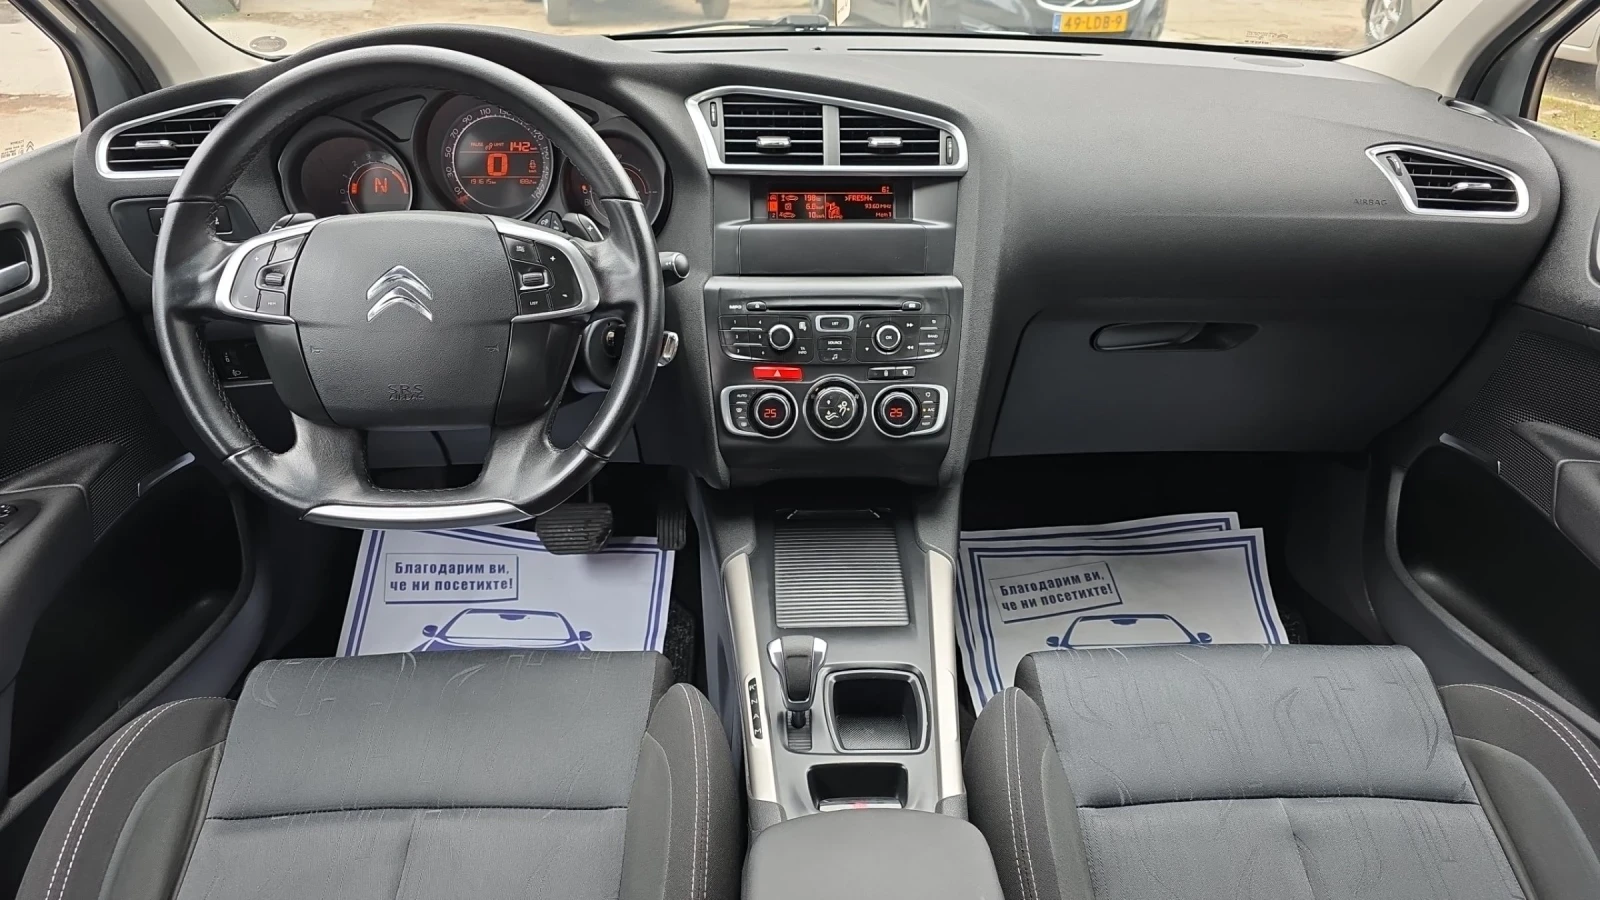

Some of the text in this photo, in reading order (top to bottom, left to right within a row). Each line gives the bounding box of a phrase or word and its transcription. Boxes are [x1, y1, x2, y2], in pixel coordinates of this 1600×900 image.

[1063, 15, 1123, 31] 49-LDB-9
[479, 107, 491, 116] 110
[462, 114, 473, 124] 90
[450, 128, 459, 139] 70
[510, 141, 530, 151] 142
[444, 146, 452, 158] 50
[487, 153, 508, 176] 0
[445, 166, 453, 178] 30
[374, 177, 388, 193] N
[453, 185, 462, 196] 10
[1353, 198, 1389, 206] AIRBAG
[387, 383, 424, 394] SRS
[763, 408, 777, 418] 25
[889, 407, 903, 418] 25
[395, 561, 510, 575] Благодарим ви,
[390, 578, 513, 591] че ни посетихте!
[999, 571, 1105, 597] Благодарим ви,
[1001, 583, 1113, 612] че ни посетихте!
